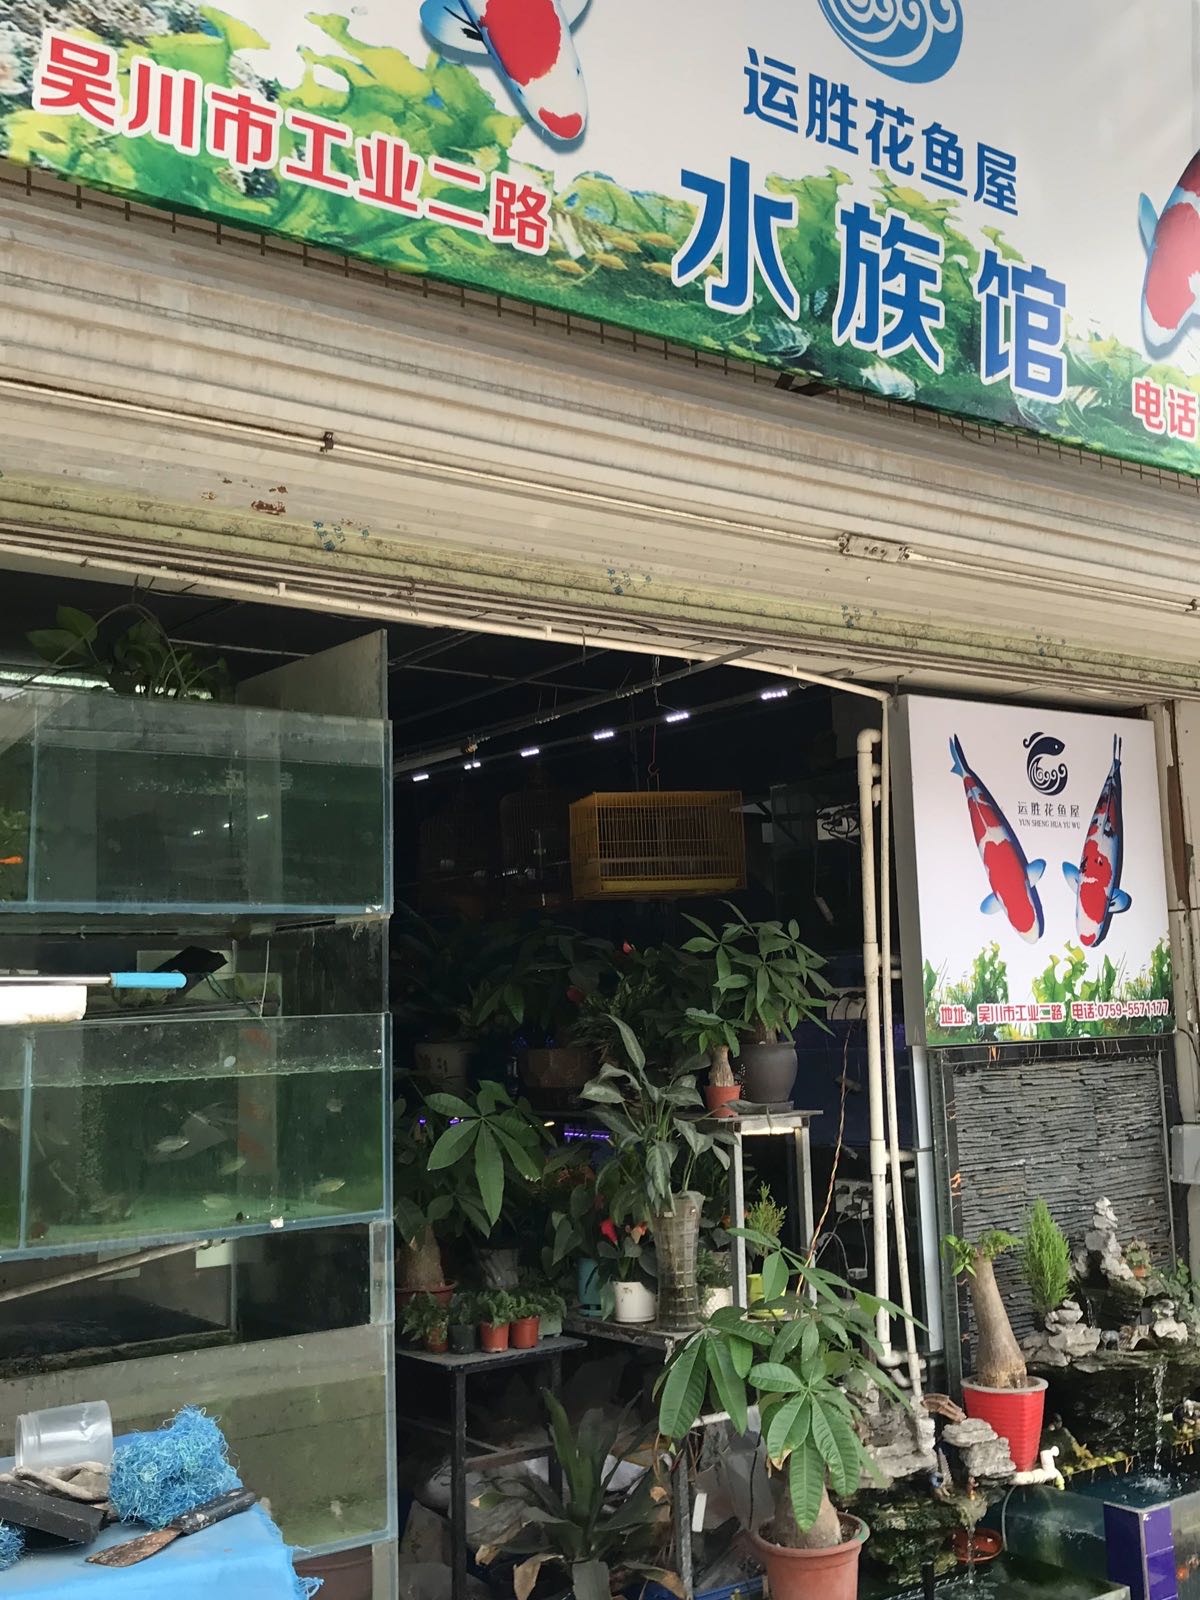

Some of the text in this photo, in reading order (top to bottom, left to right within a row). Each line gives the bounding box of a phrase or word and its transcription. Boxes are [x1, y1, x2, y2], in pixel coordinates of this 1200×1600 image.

[39, 35, 549, 251] 吴川市工业二路
[743, 47, 1018, 216] 运胜花鱼屋
[675, 157, 1066, 398] 水族馆
[1134, 380, 1197, 439] 电话
[1017, 800, 1080, 818] 运胜花鱼屋
[1018, 819, 1081, 829] YUN SHENG HUA YU WU
[978, 1004, 1063, 1023] 吴川市工业二路
